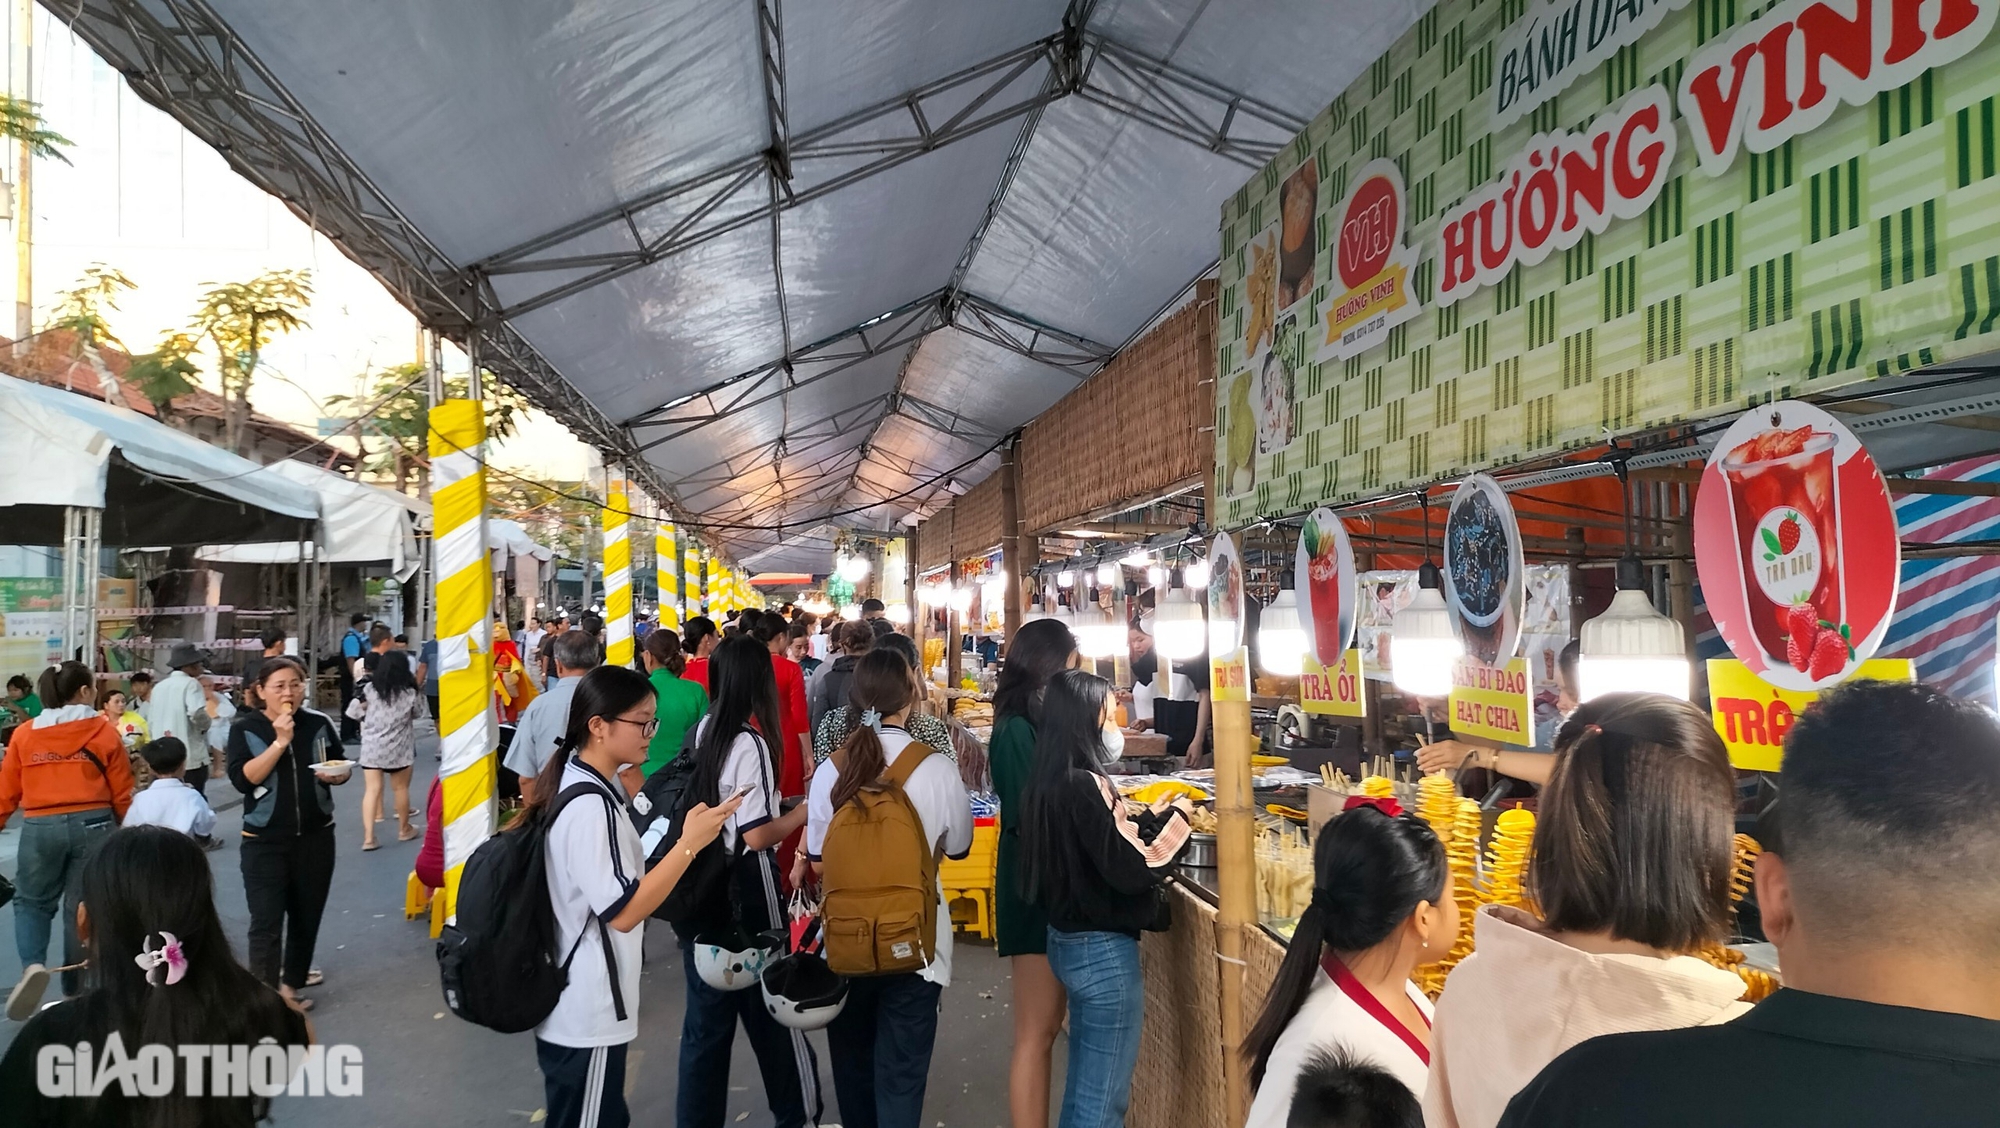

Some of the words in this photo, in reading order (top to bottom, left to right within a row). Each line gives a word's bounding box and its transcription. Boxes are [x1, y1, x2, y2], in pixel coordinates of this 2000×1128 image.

[1497, 0, 1582, 115] BÁNH
[1441, 104, 1665, 293] HƯỜNG
[1343, 194, 1391, 272] VH
[1370, 276, 1395, 303] VINH
[1301, 665, 1333, 701] TRÀ
[1338, 658, 1356, 702] ỔI
[1478, 660, 1491, 690] BÍ
[1495, 669, 1526, 694] ĐAO
[1456, 700, 1481, 727] HẠT
[1486, 705, 1520, 733] CHIA
[1716, 688, 1795, 747] TRÀ
